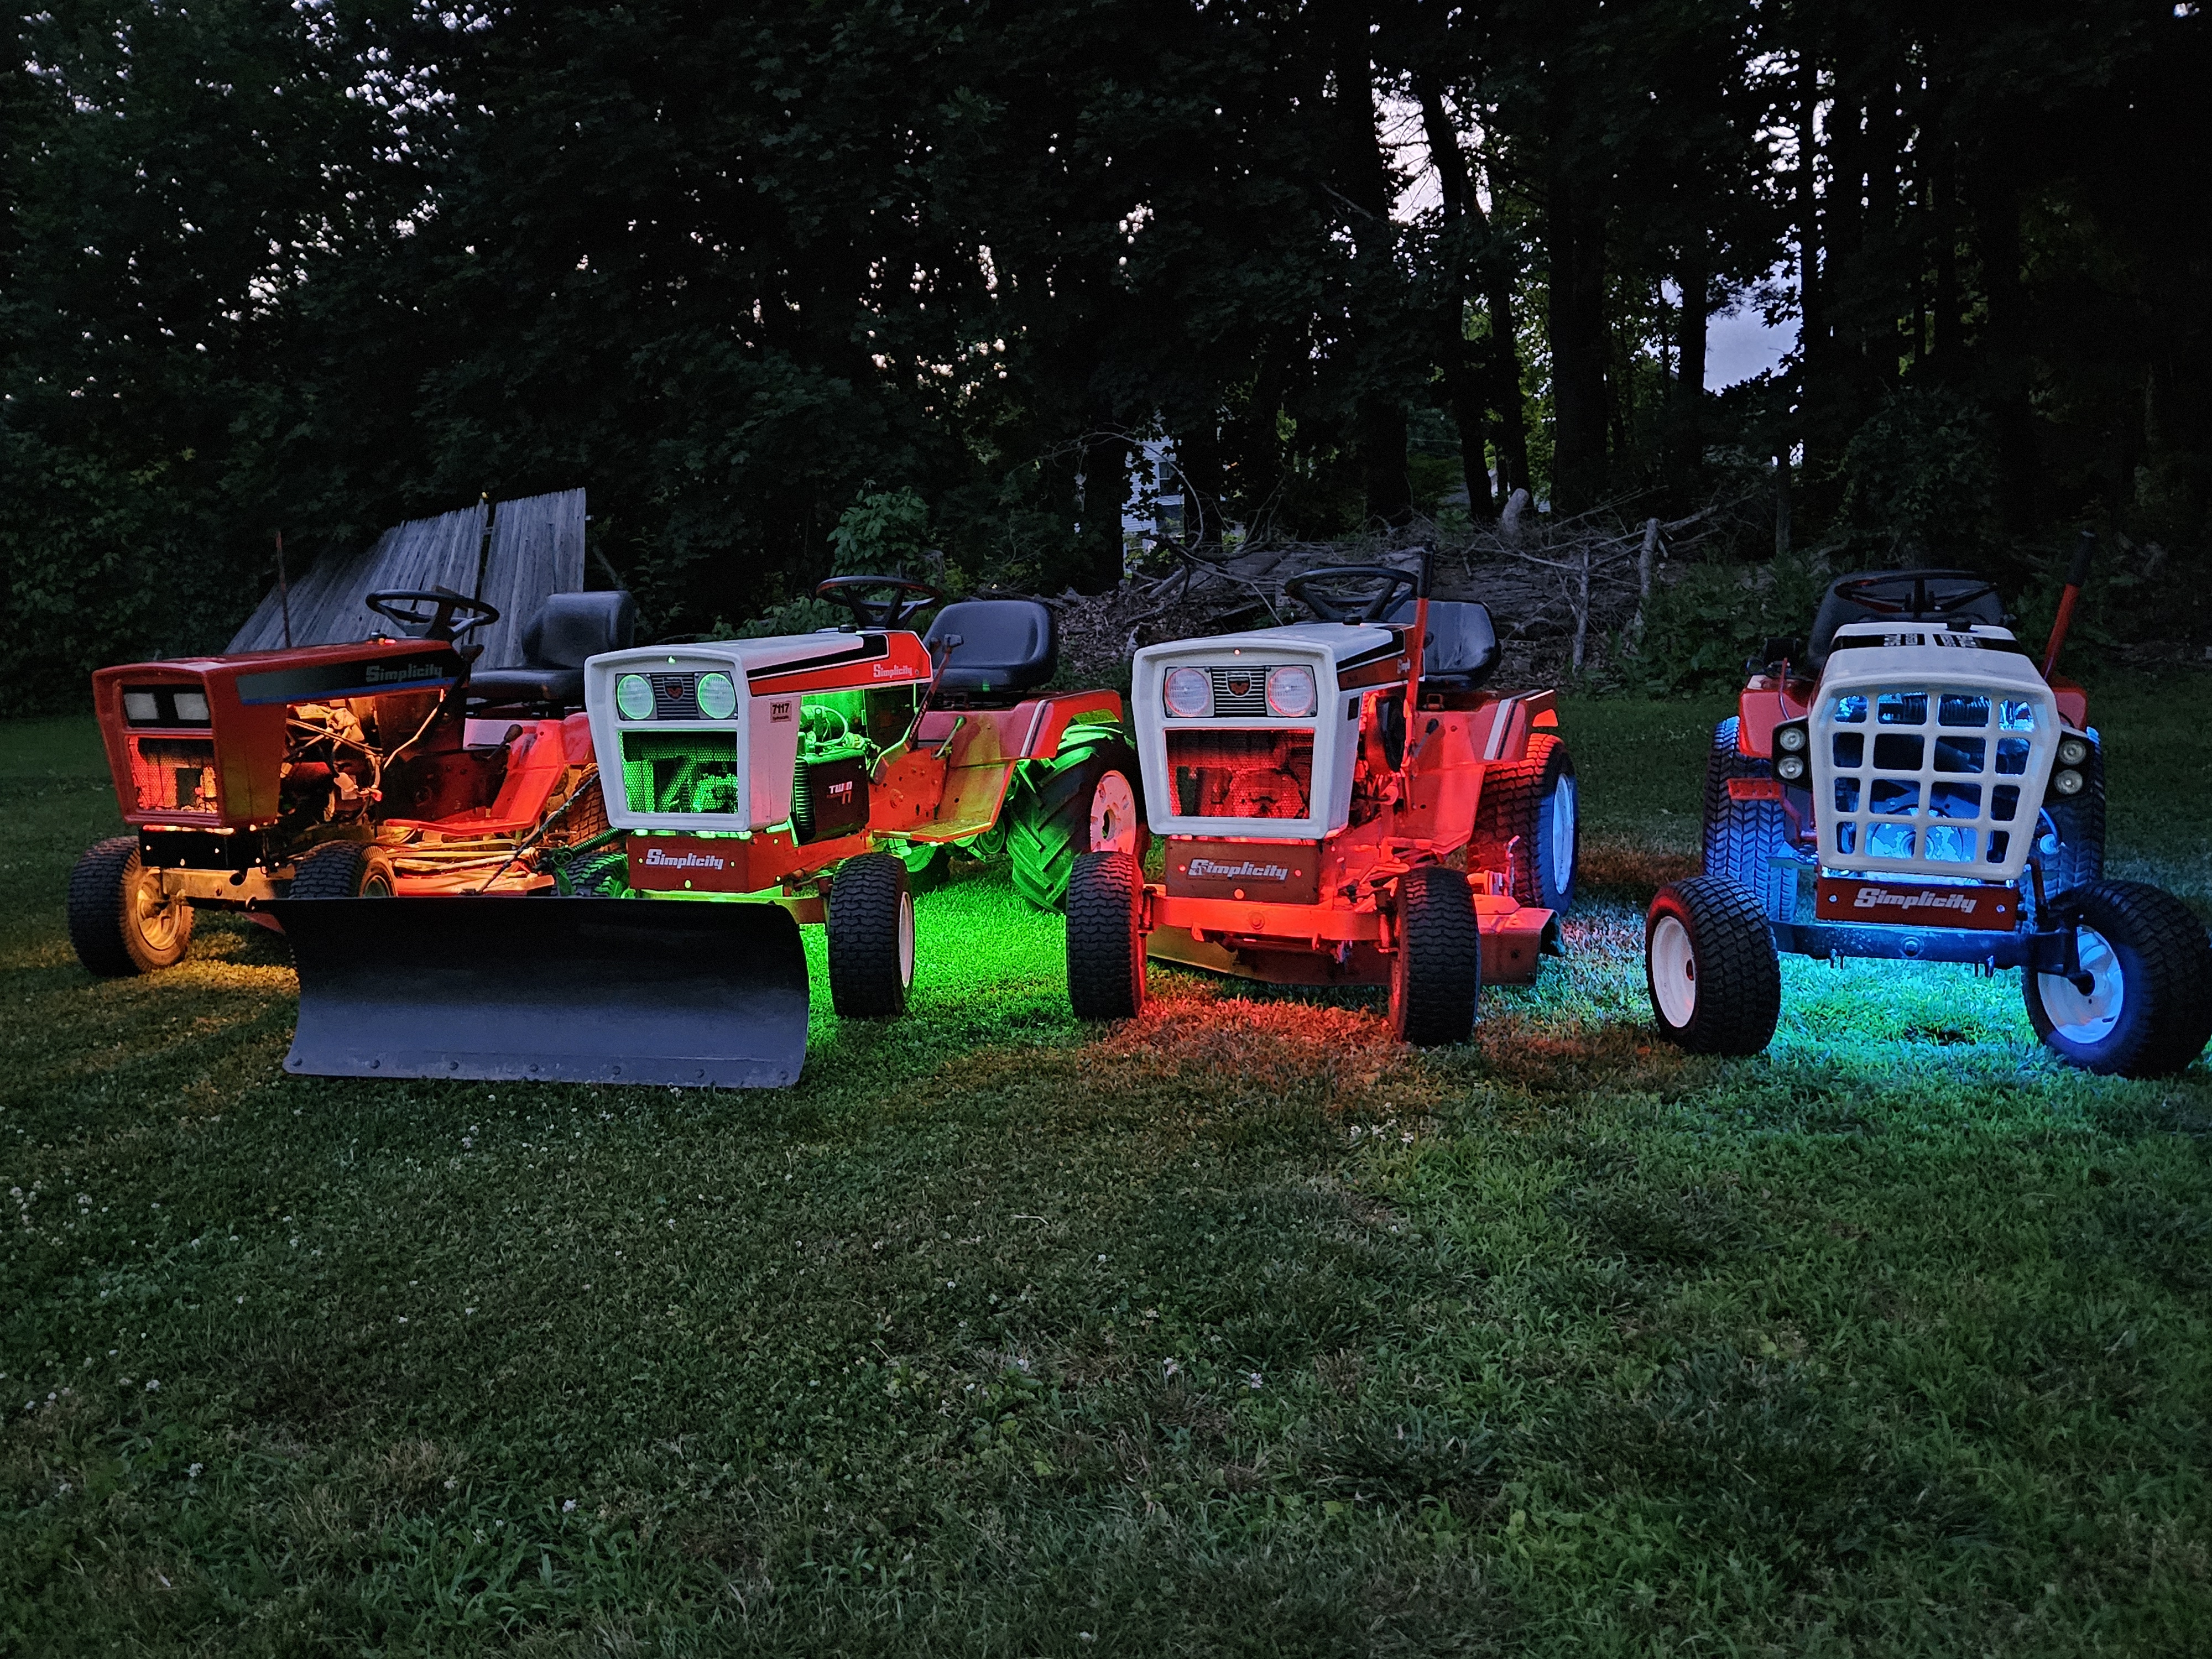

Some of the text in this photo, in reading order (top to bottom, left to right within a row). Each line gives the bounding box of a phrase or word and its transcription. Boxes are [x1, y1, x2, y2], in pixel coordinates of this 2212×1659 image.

[366, 664, 442, 682] Simplicity
[873, 664, 912, 678] Simplicity
[772, 703, 790, 714] 7117
[646, 848, 724, 870] Simplicity
[1188, 859, 1288, 880] Simplicity
[1854, 888, 1976, 913] Simplicity
